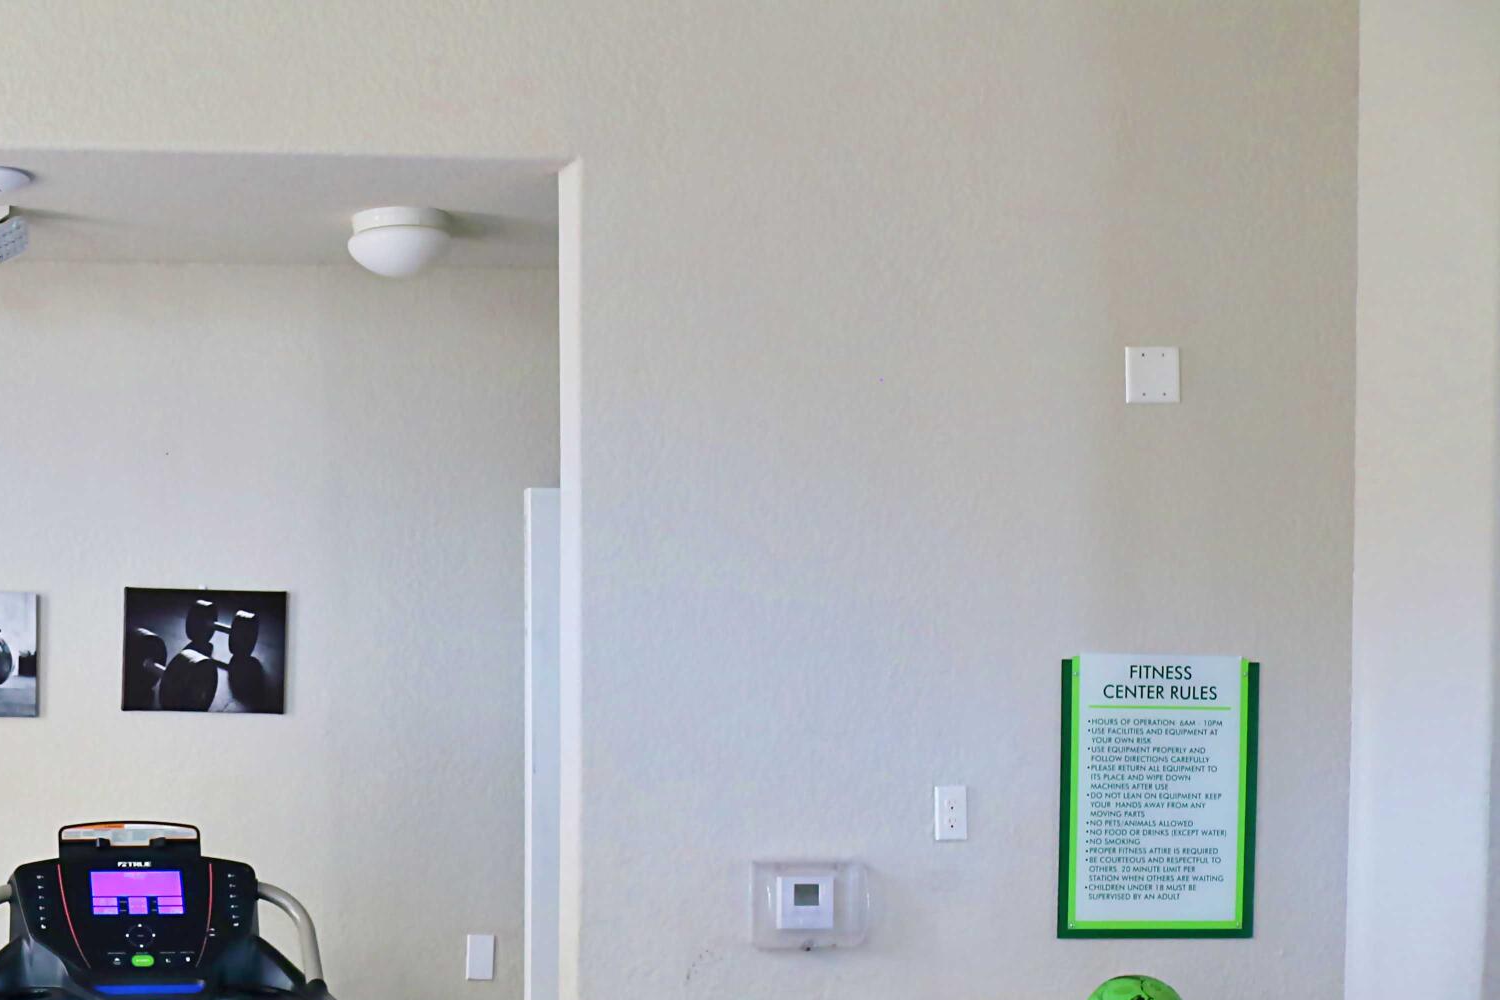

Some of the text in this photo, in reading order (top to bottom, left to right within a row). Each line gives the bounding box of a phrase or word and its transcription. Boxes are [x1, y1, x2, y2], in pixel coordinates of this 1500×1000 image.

[1129, 665, 1193, 680] FITNESS
[1103, 684, 1218, 700] CENTER RULES
[1091, 764, 1115, 772] PLEASE
[1090, 810, 1146, 818] MOVING PARTS
